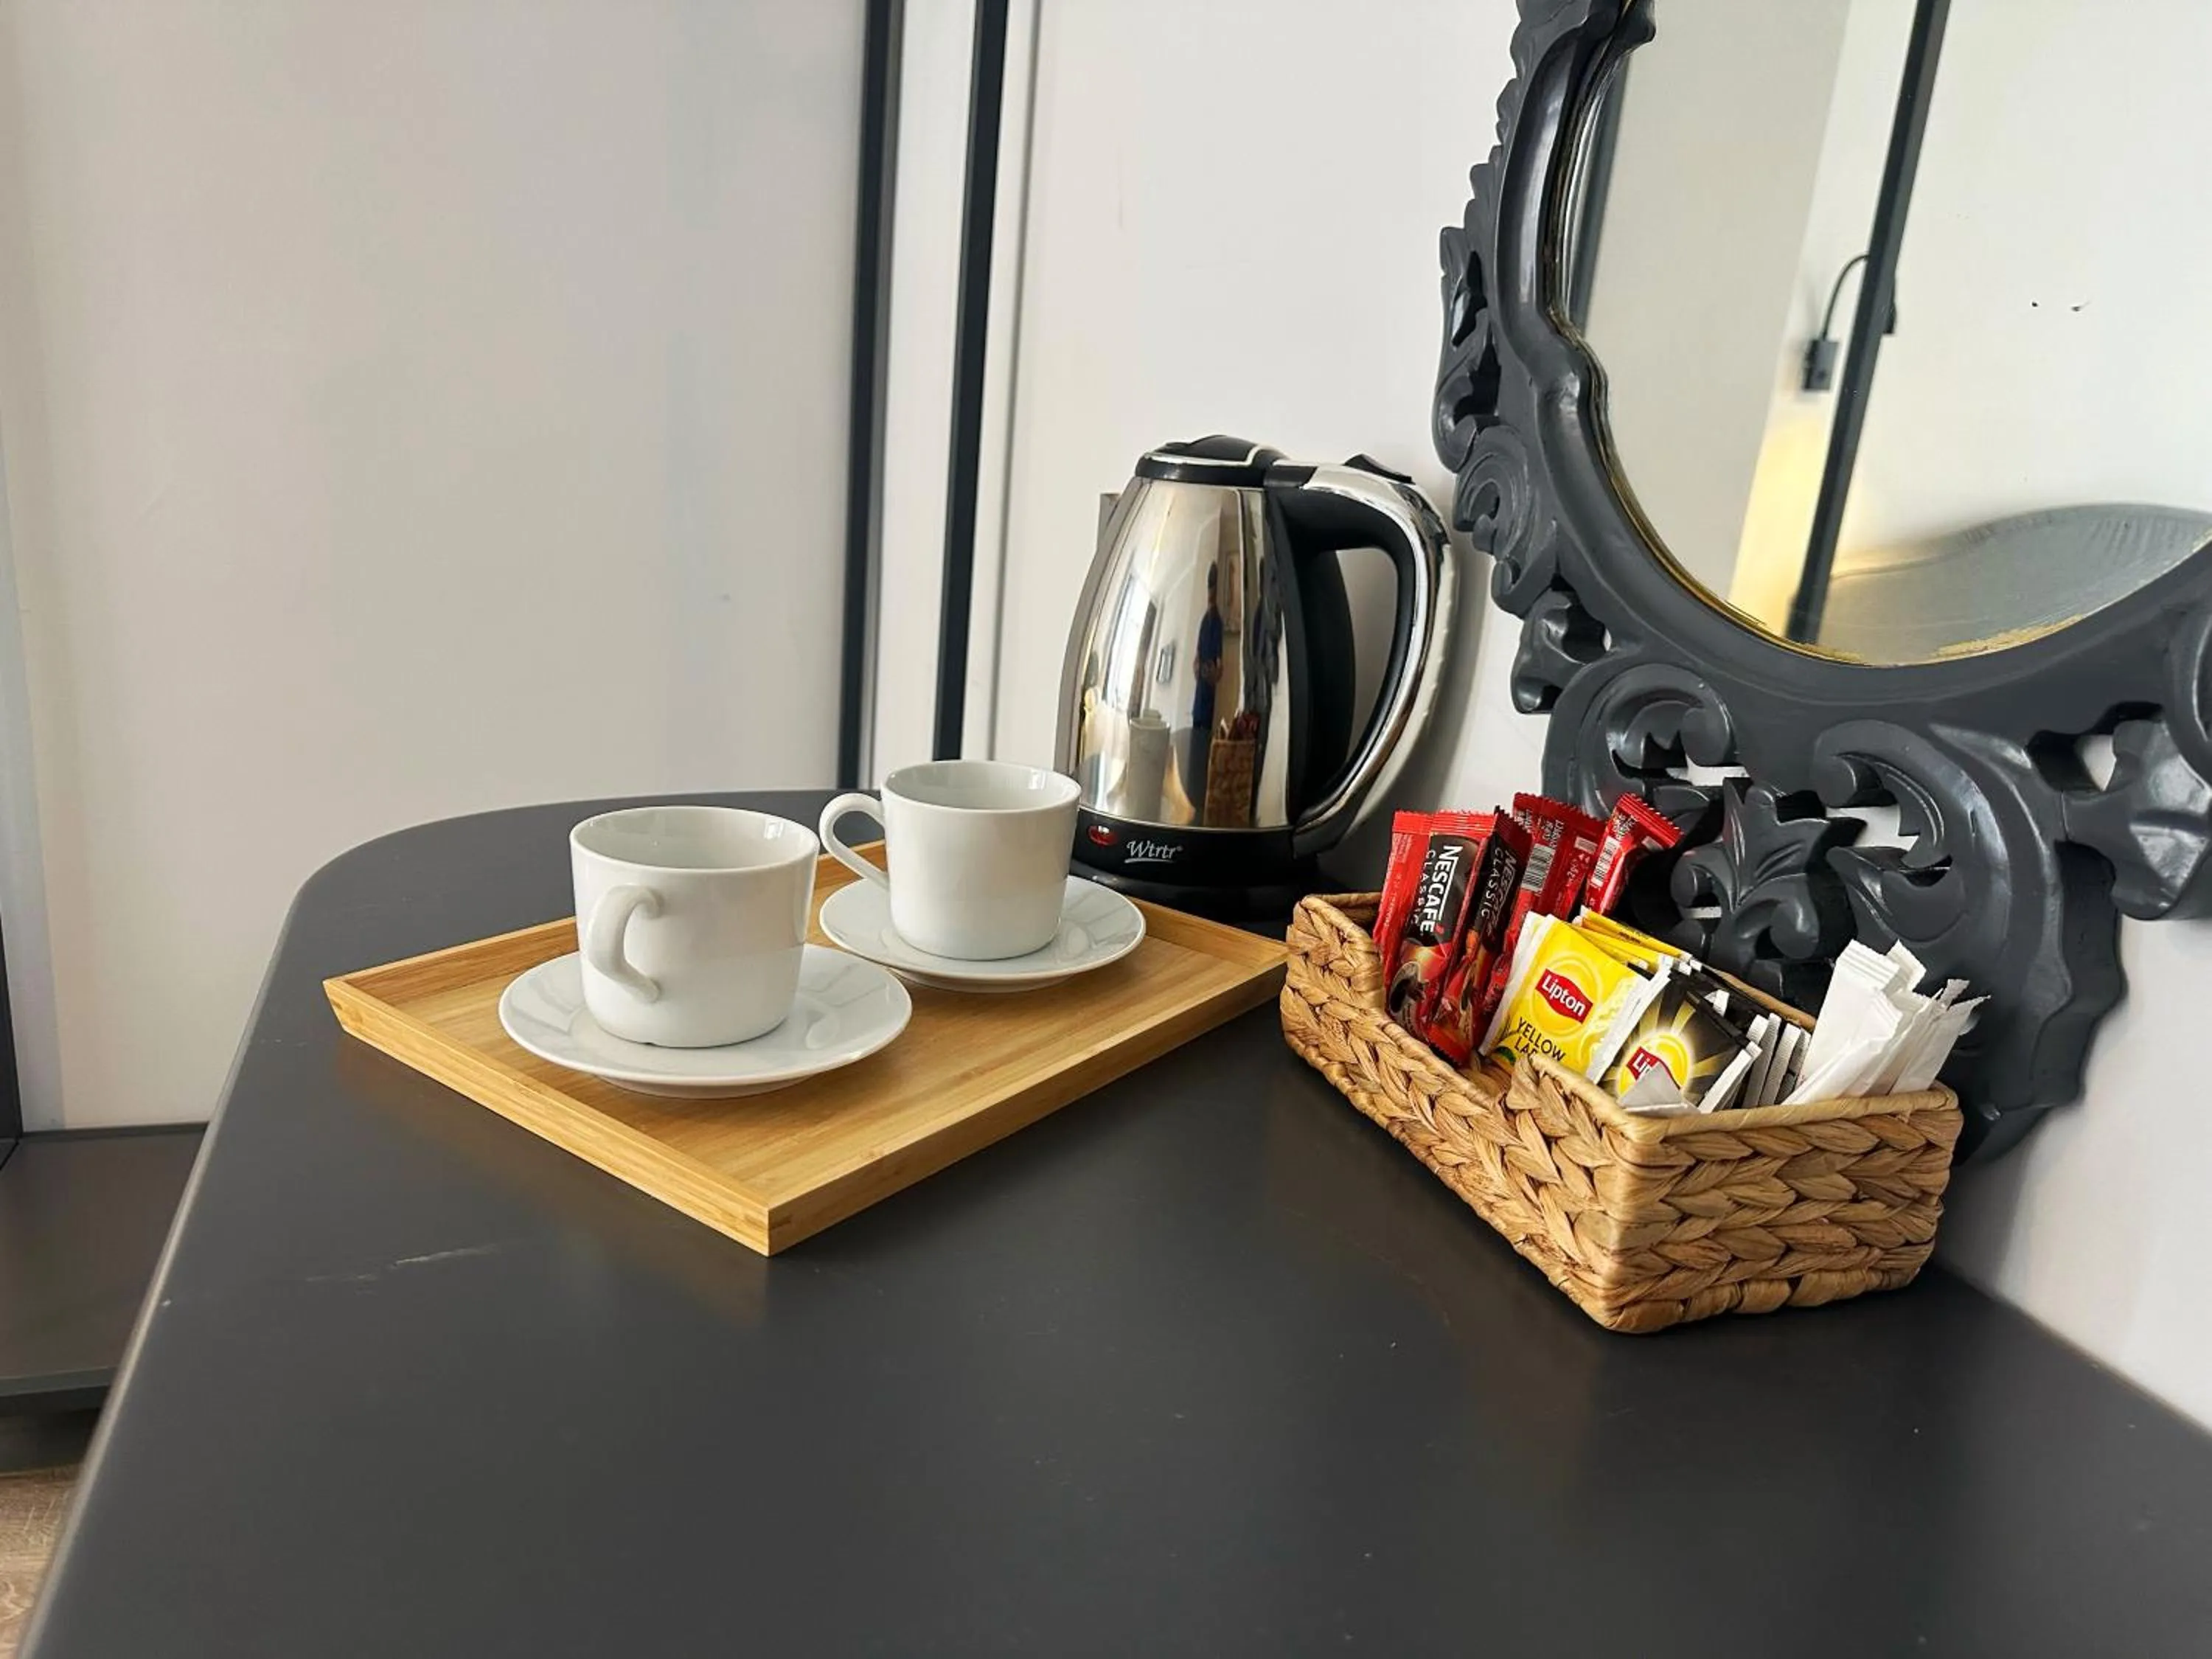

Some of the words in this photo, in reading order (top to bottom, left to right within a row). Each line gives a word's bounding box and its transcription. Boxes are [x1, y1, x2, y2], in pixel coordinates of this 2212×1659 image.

[1411, 849, 1436, 925] CLASSIC
[1481, 847, 1504, 919] CLASSIC
[1540, 974, 1587, 1018] Lipton
[1516, 1017, 1567, 1062] YELLOW
